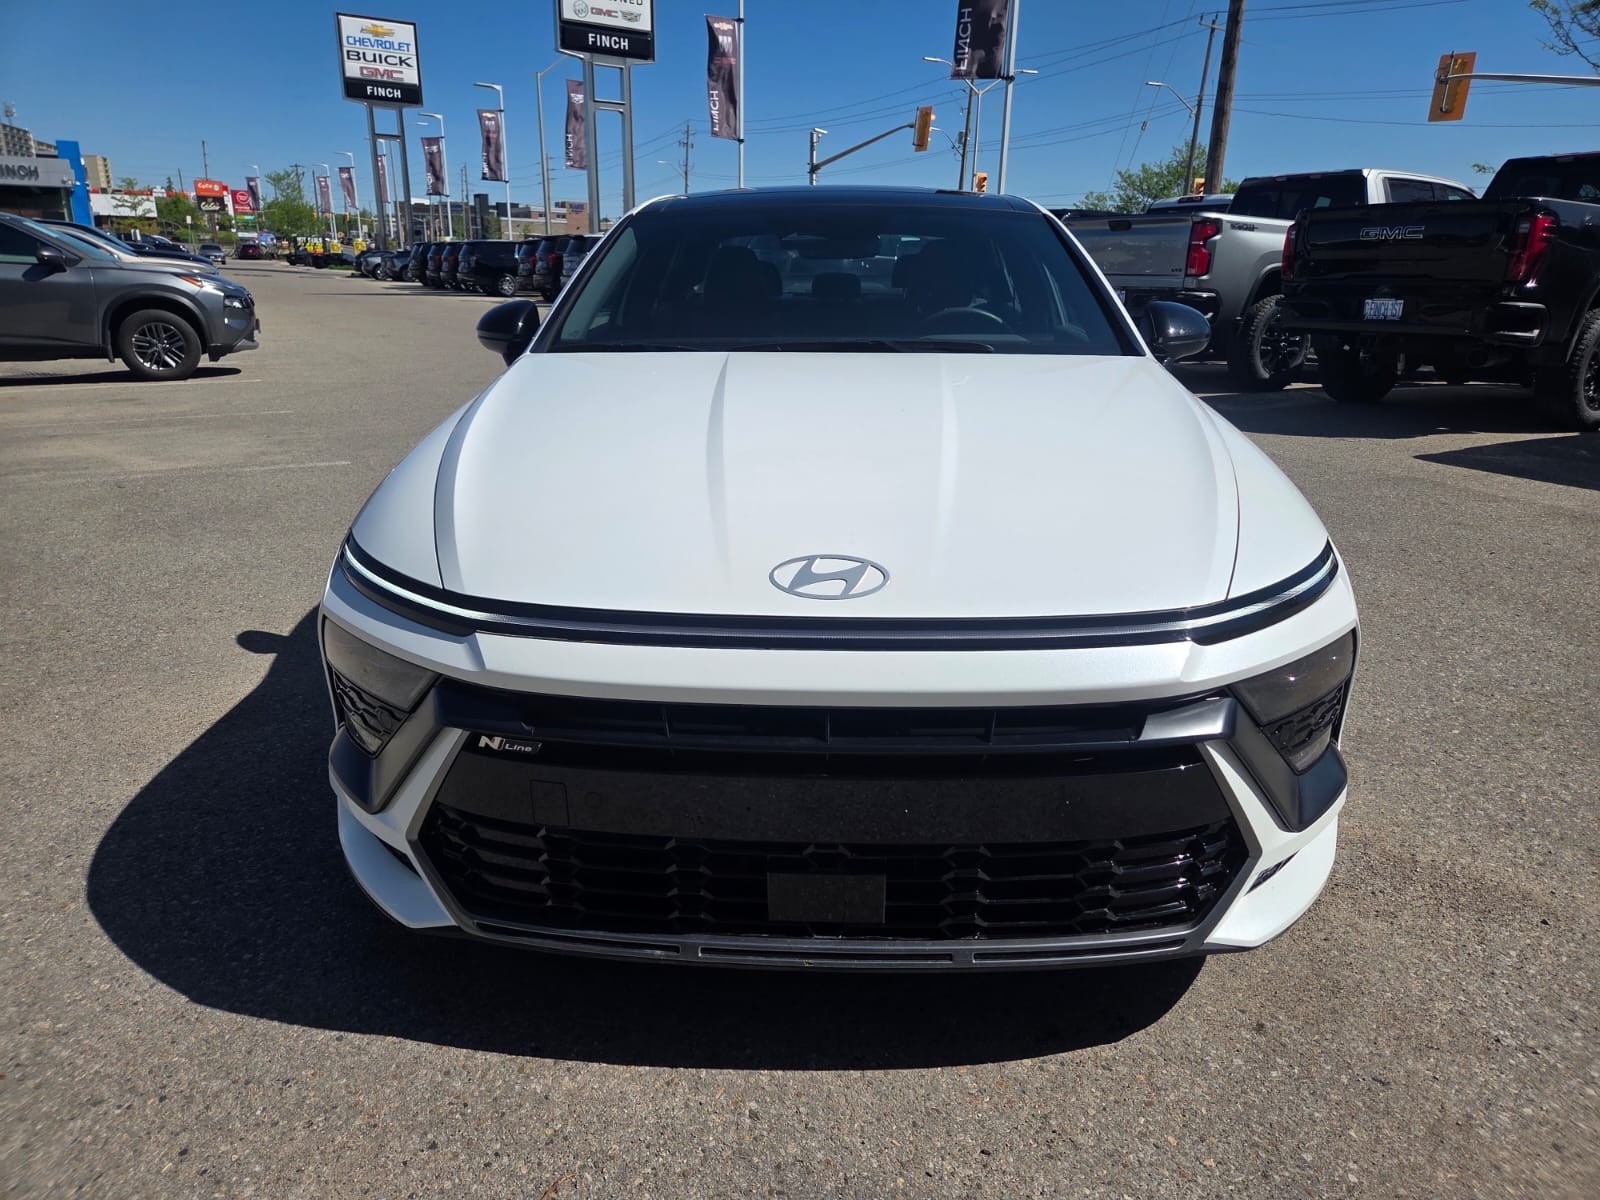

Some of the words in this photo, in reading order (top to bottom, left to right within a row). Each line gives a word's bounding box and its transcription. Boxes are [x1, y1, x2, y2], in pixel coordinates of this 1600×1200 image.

[590, 7, 619, 18] GMC
[346, 35, 412, 53] CHEVROLET
[588, 33, 629, 50] FINCH
[346, 49, 414, 68] BUICK
[359, 65, 404, 81] GMC
[366, 85, 402, 98] FINCH
[0, 163, 39, 181] INCH
[1360, 226, 1425, 240] GMC
[479, 735, 505, 751] N
[505, 743, 532, 752] Line
